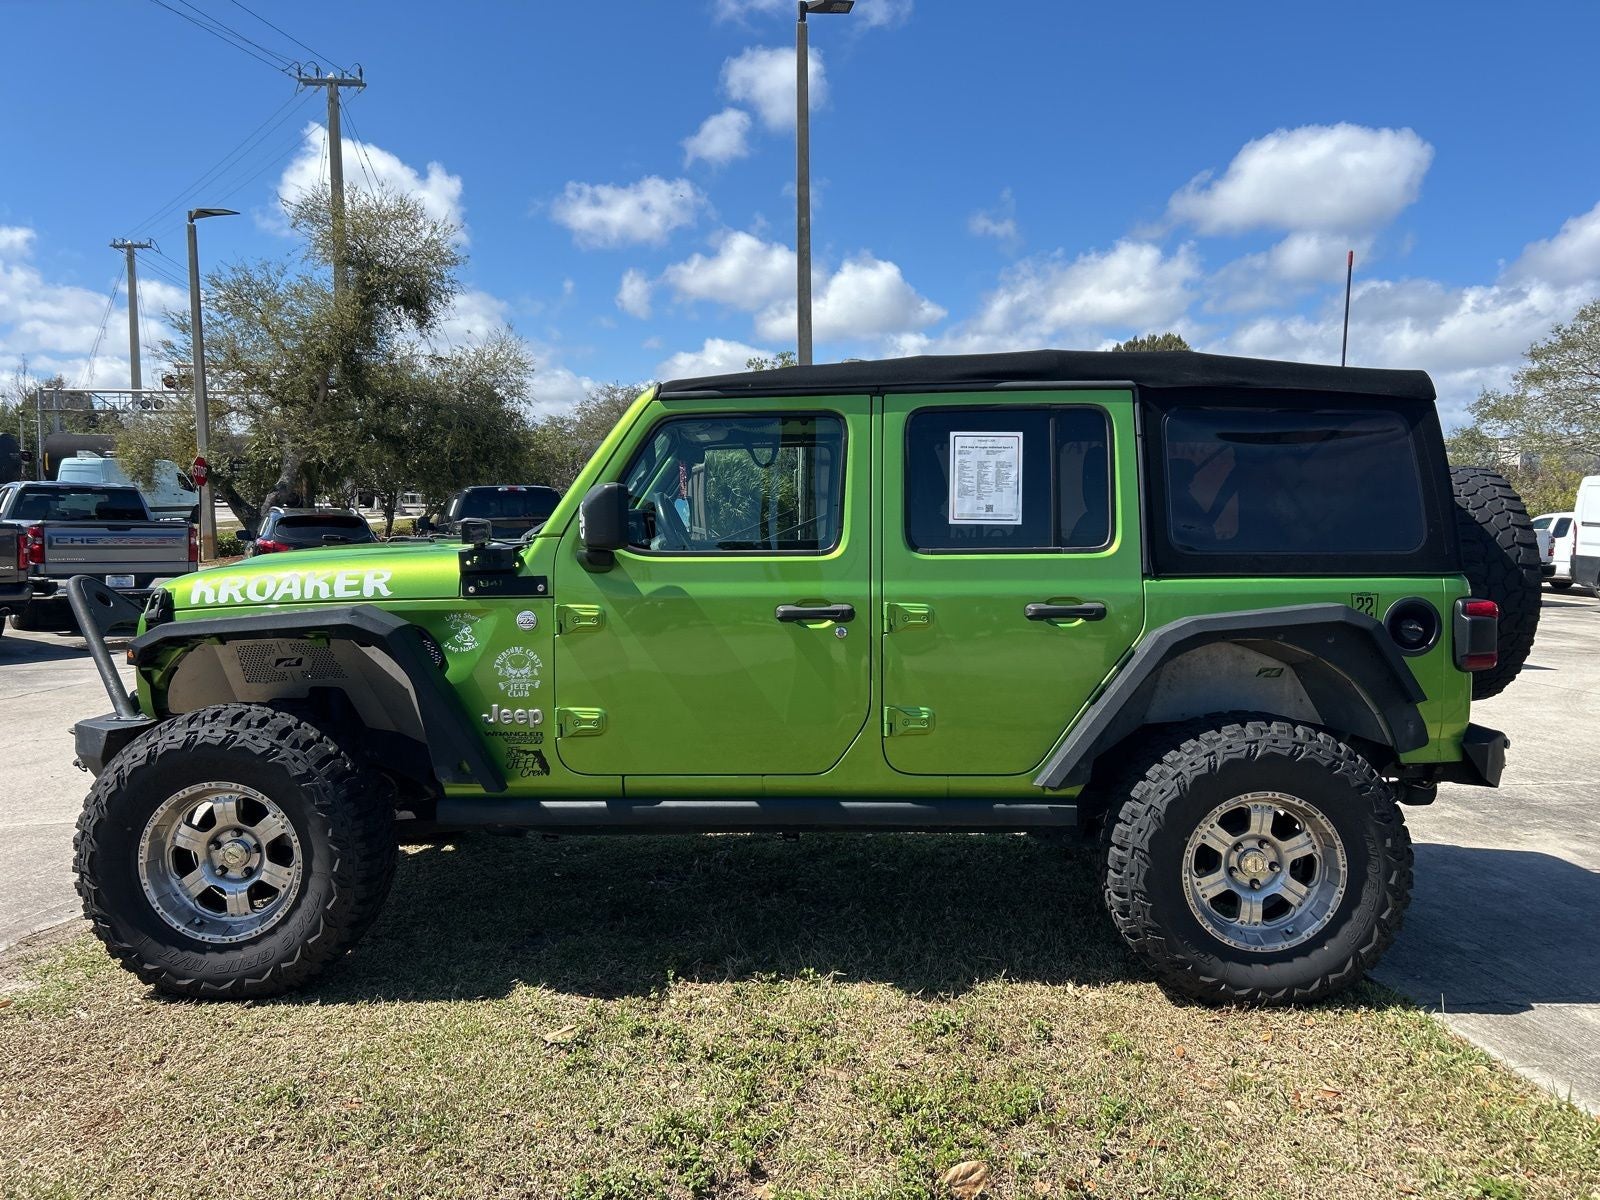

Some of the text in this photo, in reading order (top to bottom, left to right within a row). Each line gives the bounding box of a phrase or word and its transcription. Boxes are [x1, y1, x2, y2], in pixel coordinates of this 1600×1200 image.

[194, 465, 207, 477] STOP
[190, 570, 393, 605] KROAKER
[493, 646, 543, 668] TREASURE COAST
[481, 703, 544, 728] Jeep
[158, 951, 210, 972] M/T
[214, 947, 276, 975] GRIP
